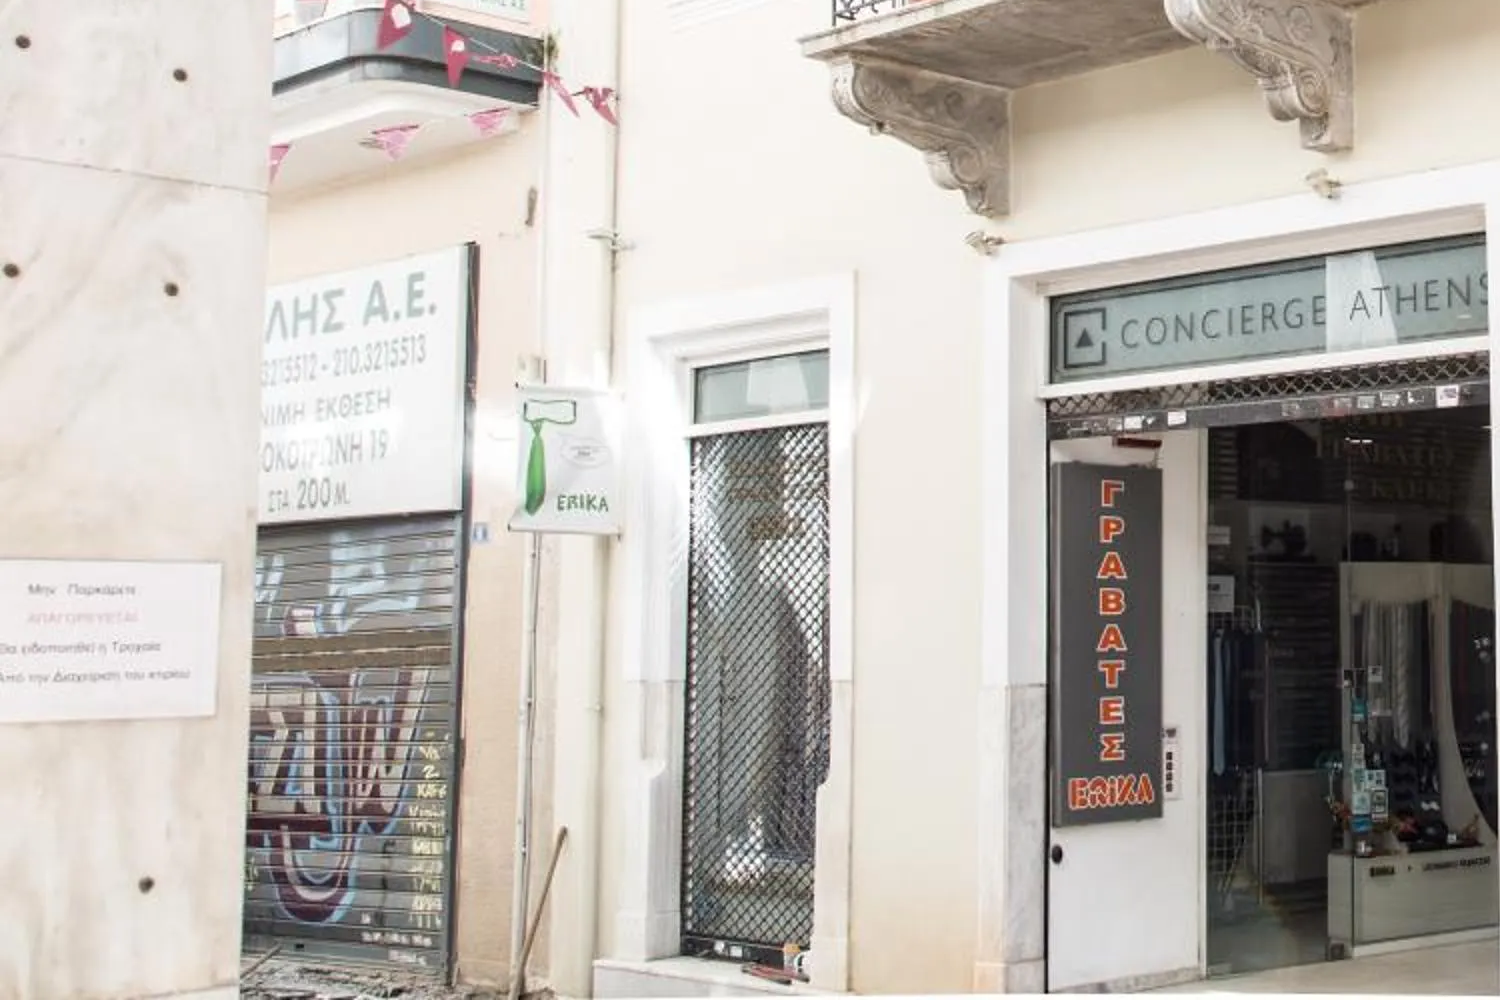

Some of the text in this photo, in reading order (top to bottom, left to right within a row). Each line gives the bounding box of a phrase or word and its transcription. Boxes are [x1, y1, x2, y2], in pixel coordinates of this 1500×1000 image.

[363, 271, 438, 326] Α.Ε.
[1121, 295, 1327, 349] CONCIERGE
[316, 388, 390, 421] ΕΚΘΕΣΗ
[371, 429, 388, 461] 19
[557, 494, 609, 512] ERIKA
[1096, 479, 1127, 761] ΓΡΑΒΑΤΕΣ
[1068, 773, 1155, 811] ERIKA
